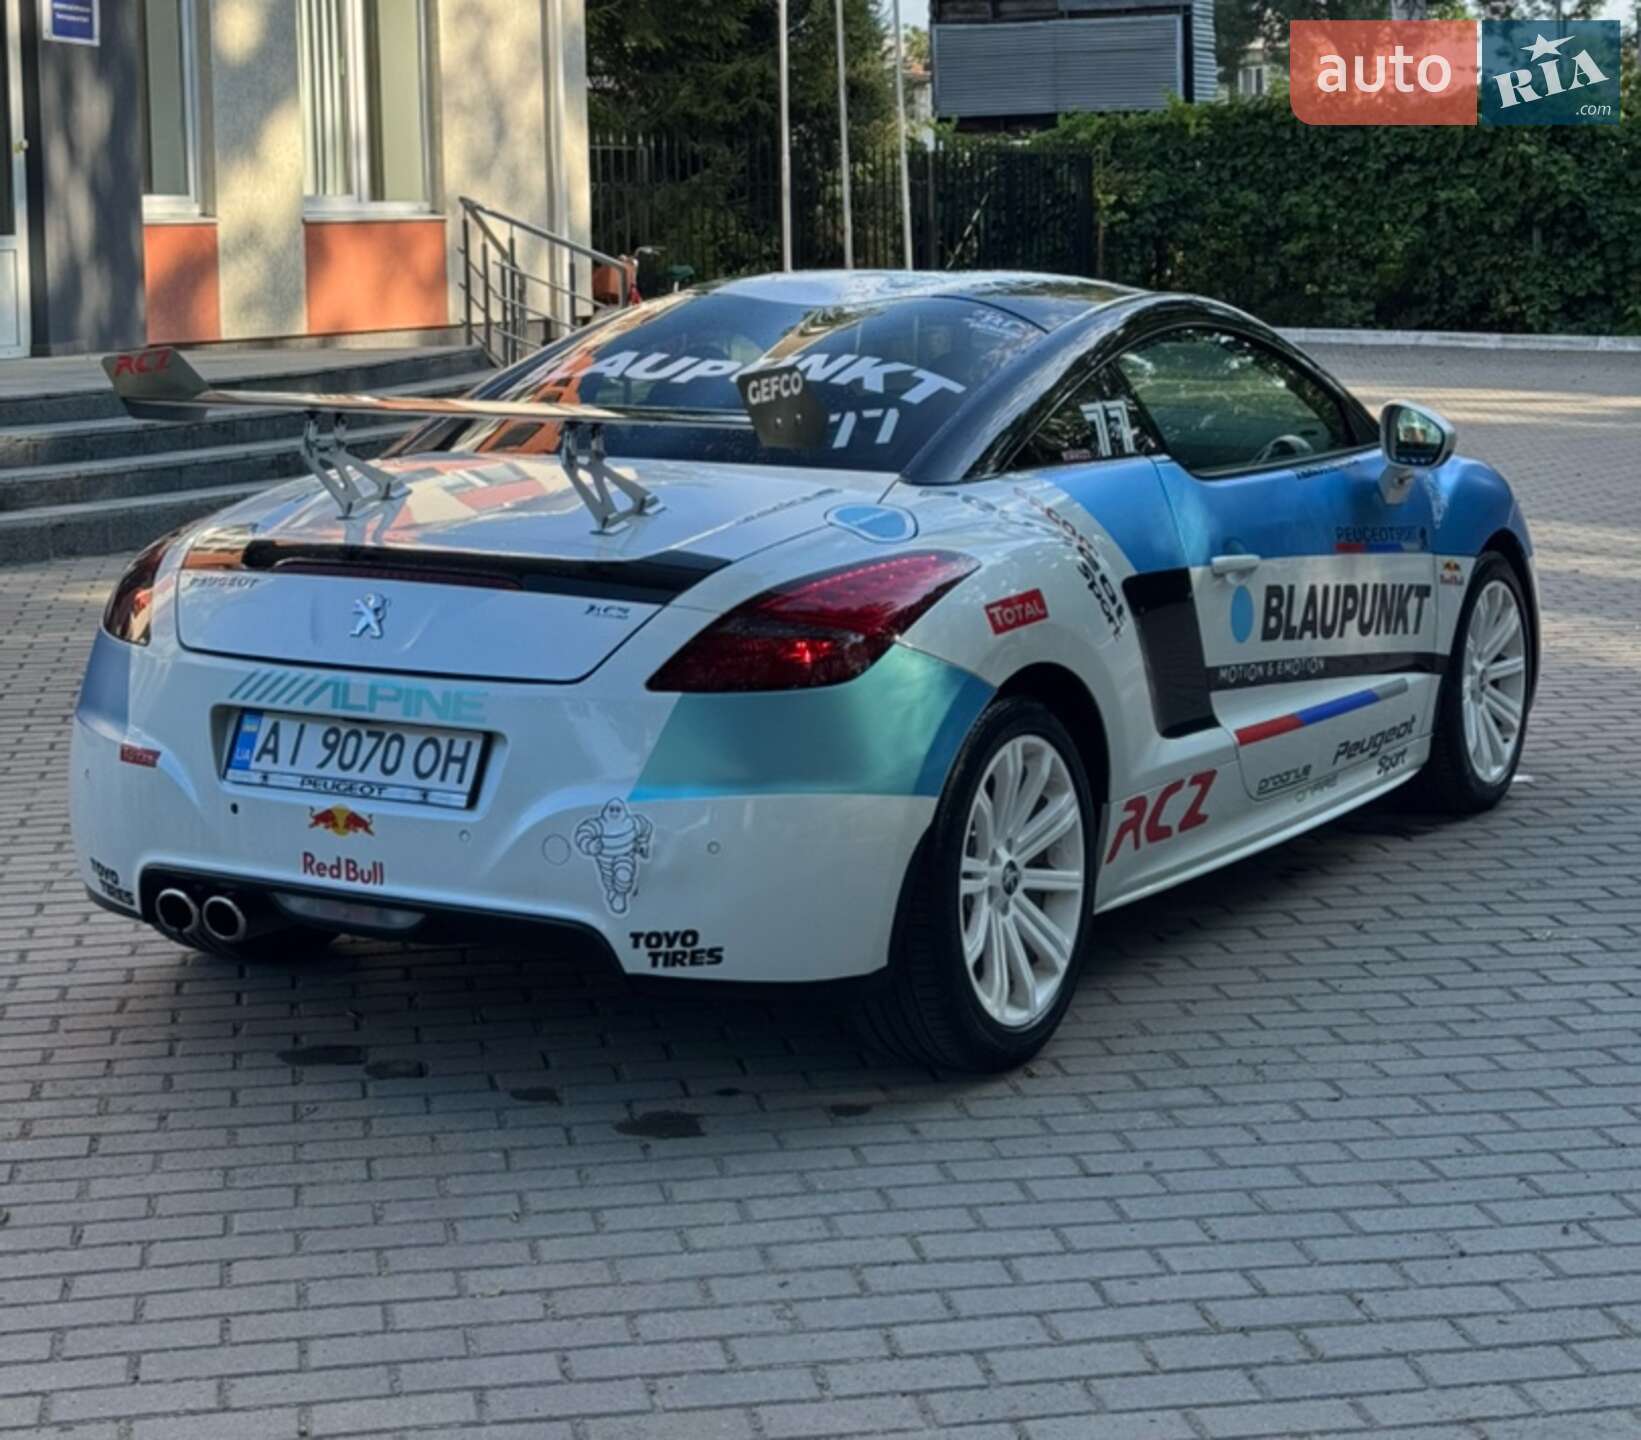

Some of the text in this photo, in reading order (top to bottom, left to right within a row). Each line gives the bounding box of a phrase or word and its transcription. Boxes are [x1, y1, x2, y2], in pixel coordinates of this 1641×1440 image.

[748, 371, 803, 405] GEFCO
[1079, 400, 1136, 457] 77
[1261, 584, 1431, 642] BLAUPUNKT
[303, 676, 489, 724] ALPINE
[255, 720, 473, 785] AI 9070 OH
[1332, 714, 1416, 765] Peugeot
[300, 776, 390, 798] PEUGEOT
[1105, 767, 1218, 865] RCZ
[302, 851, 384, 886] Red Bull
[629, 928, 700, 950] TOYO
[647, 946, 725, 969] TIRES
